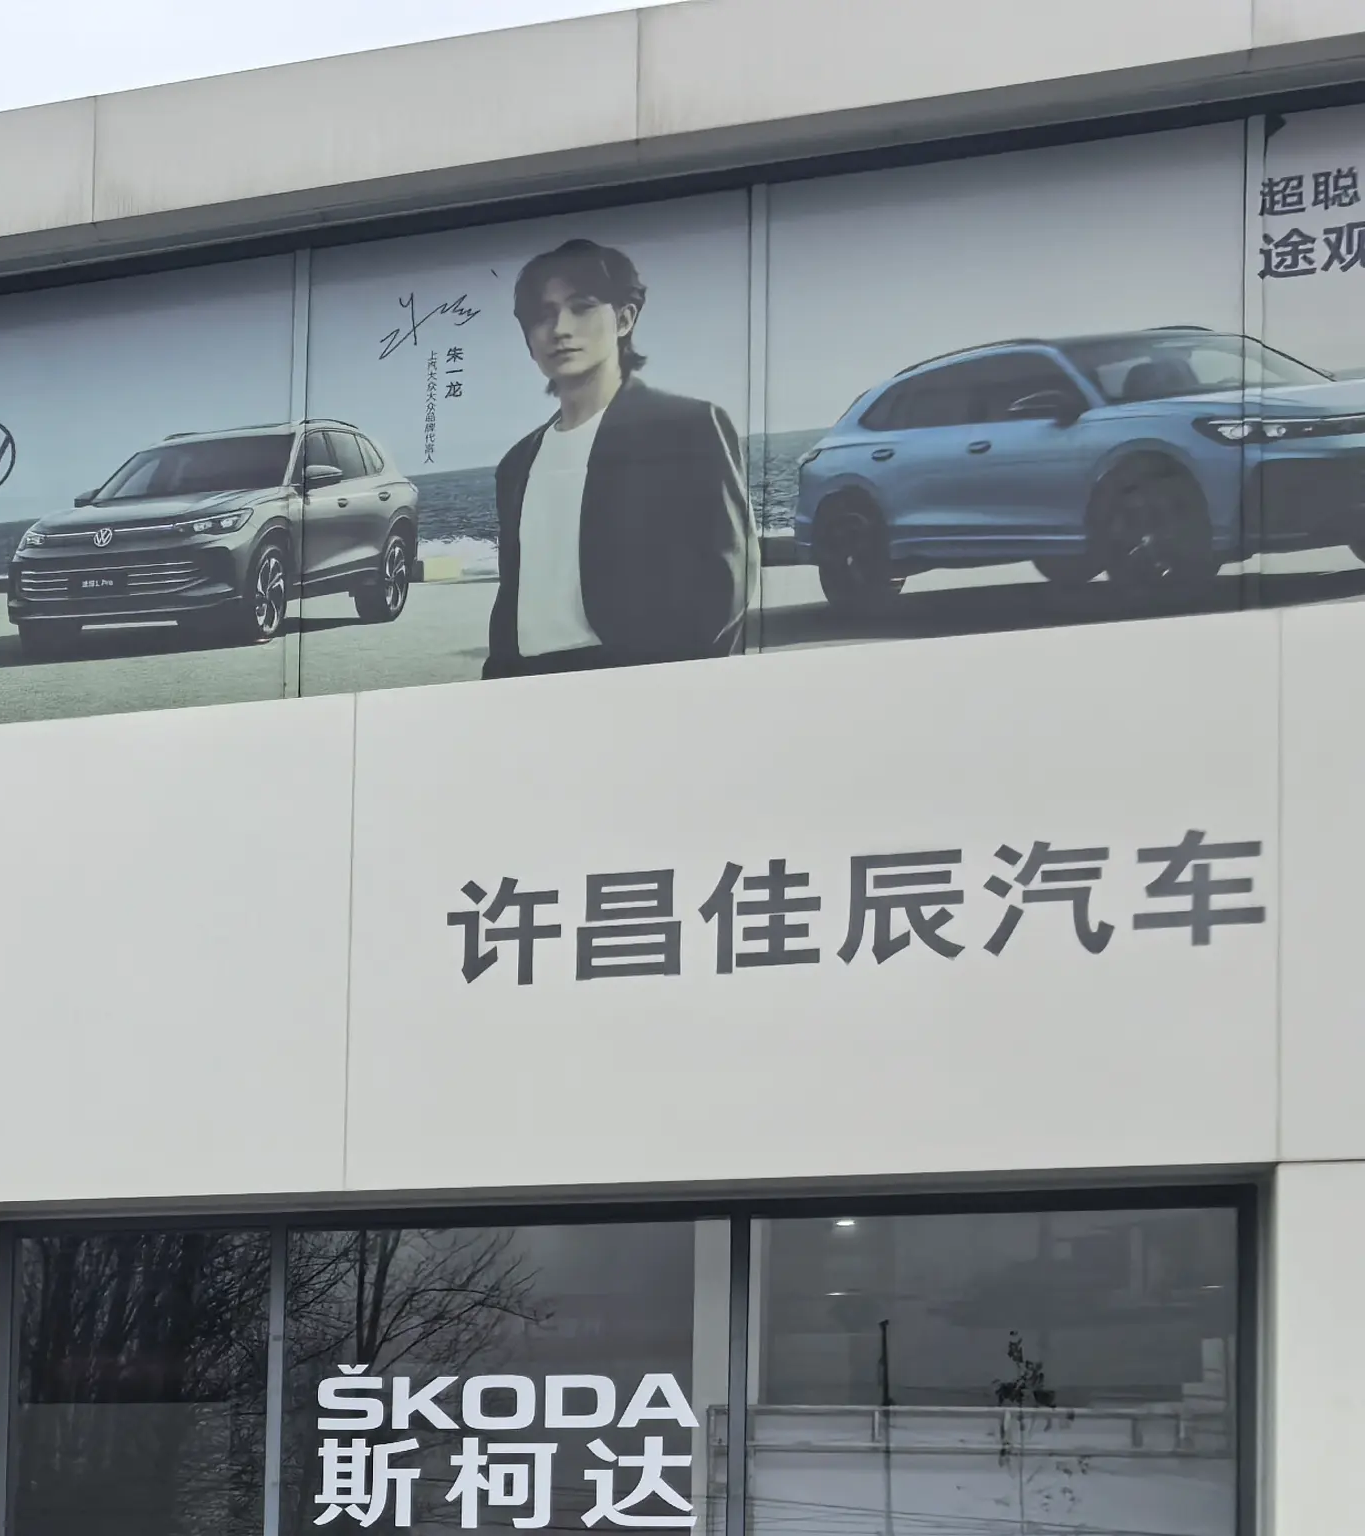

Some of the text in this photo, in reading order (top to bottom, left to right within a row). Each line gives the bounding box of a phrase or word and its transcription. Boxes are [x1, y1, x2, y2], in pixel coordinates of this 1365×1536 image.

[1258, 166, 1362, 217] 超聪
[1257, 221, 1365, 280] 途观
[444, 346, 465, 399] 朱一龙
[445, 828, 1268, 987] 许昌佳辰汽车
[316, 1363, 701, 1431] ŠKODA
[312, 1435, 699, 1529] 斯柯达
